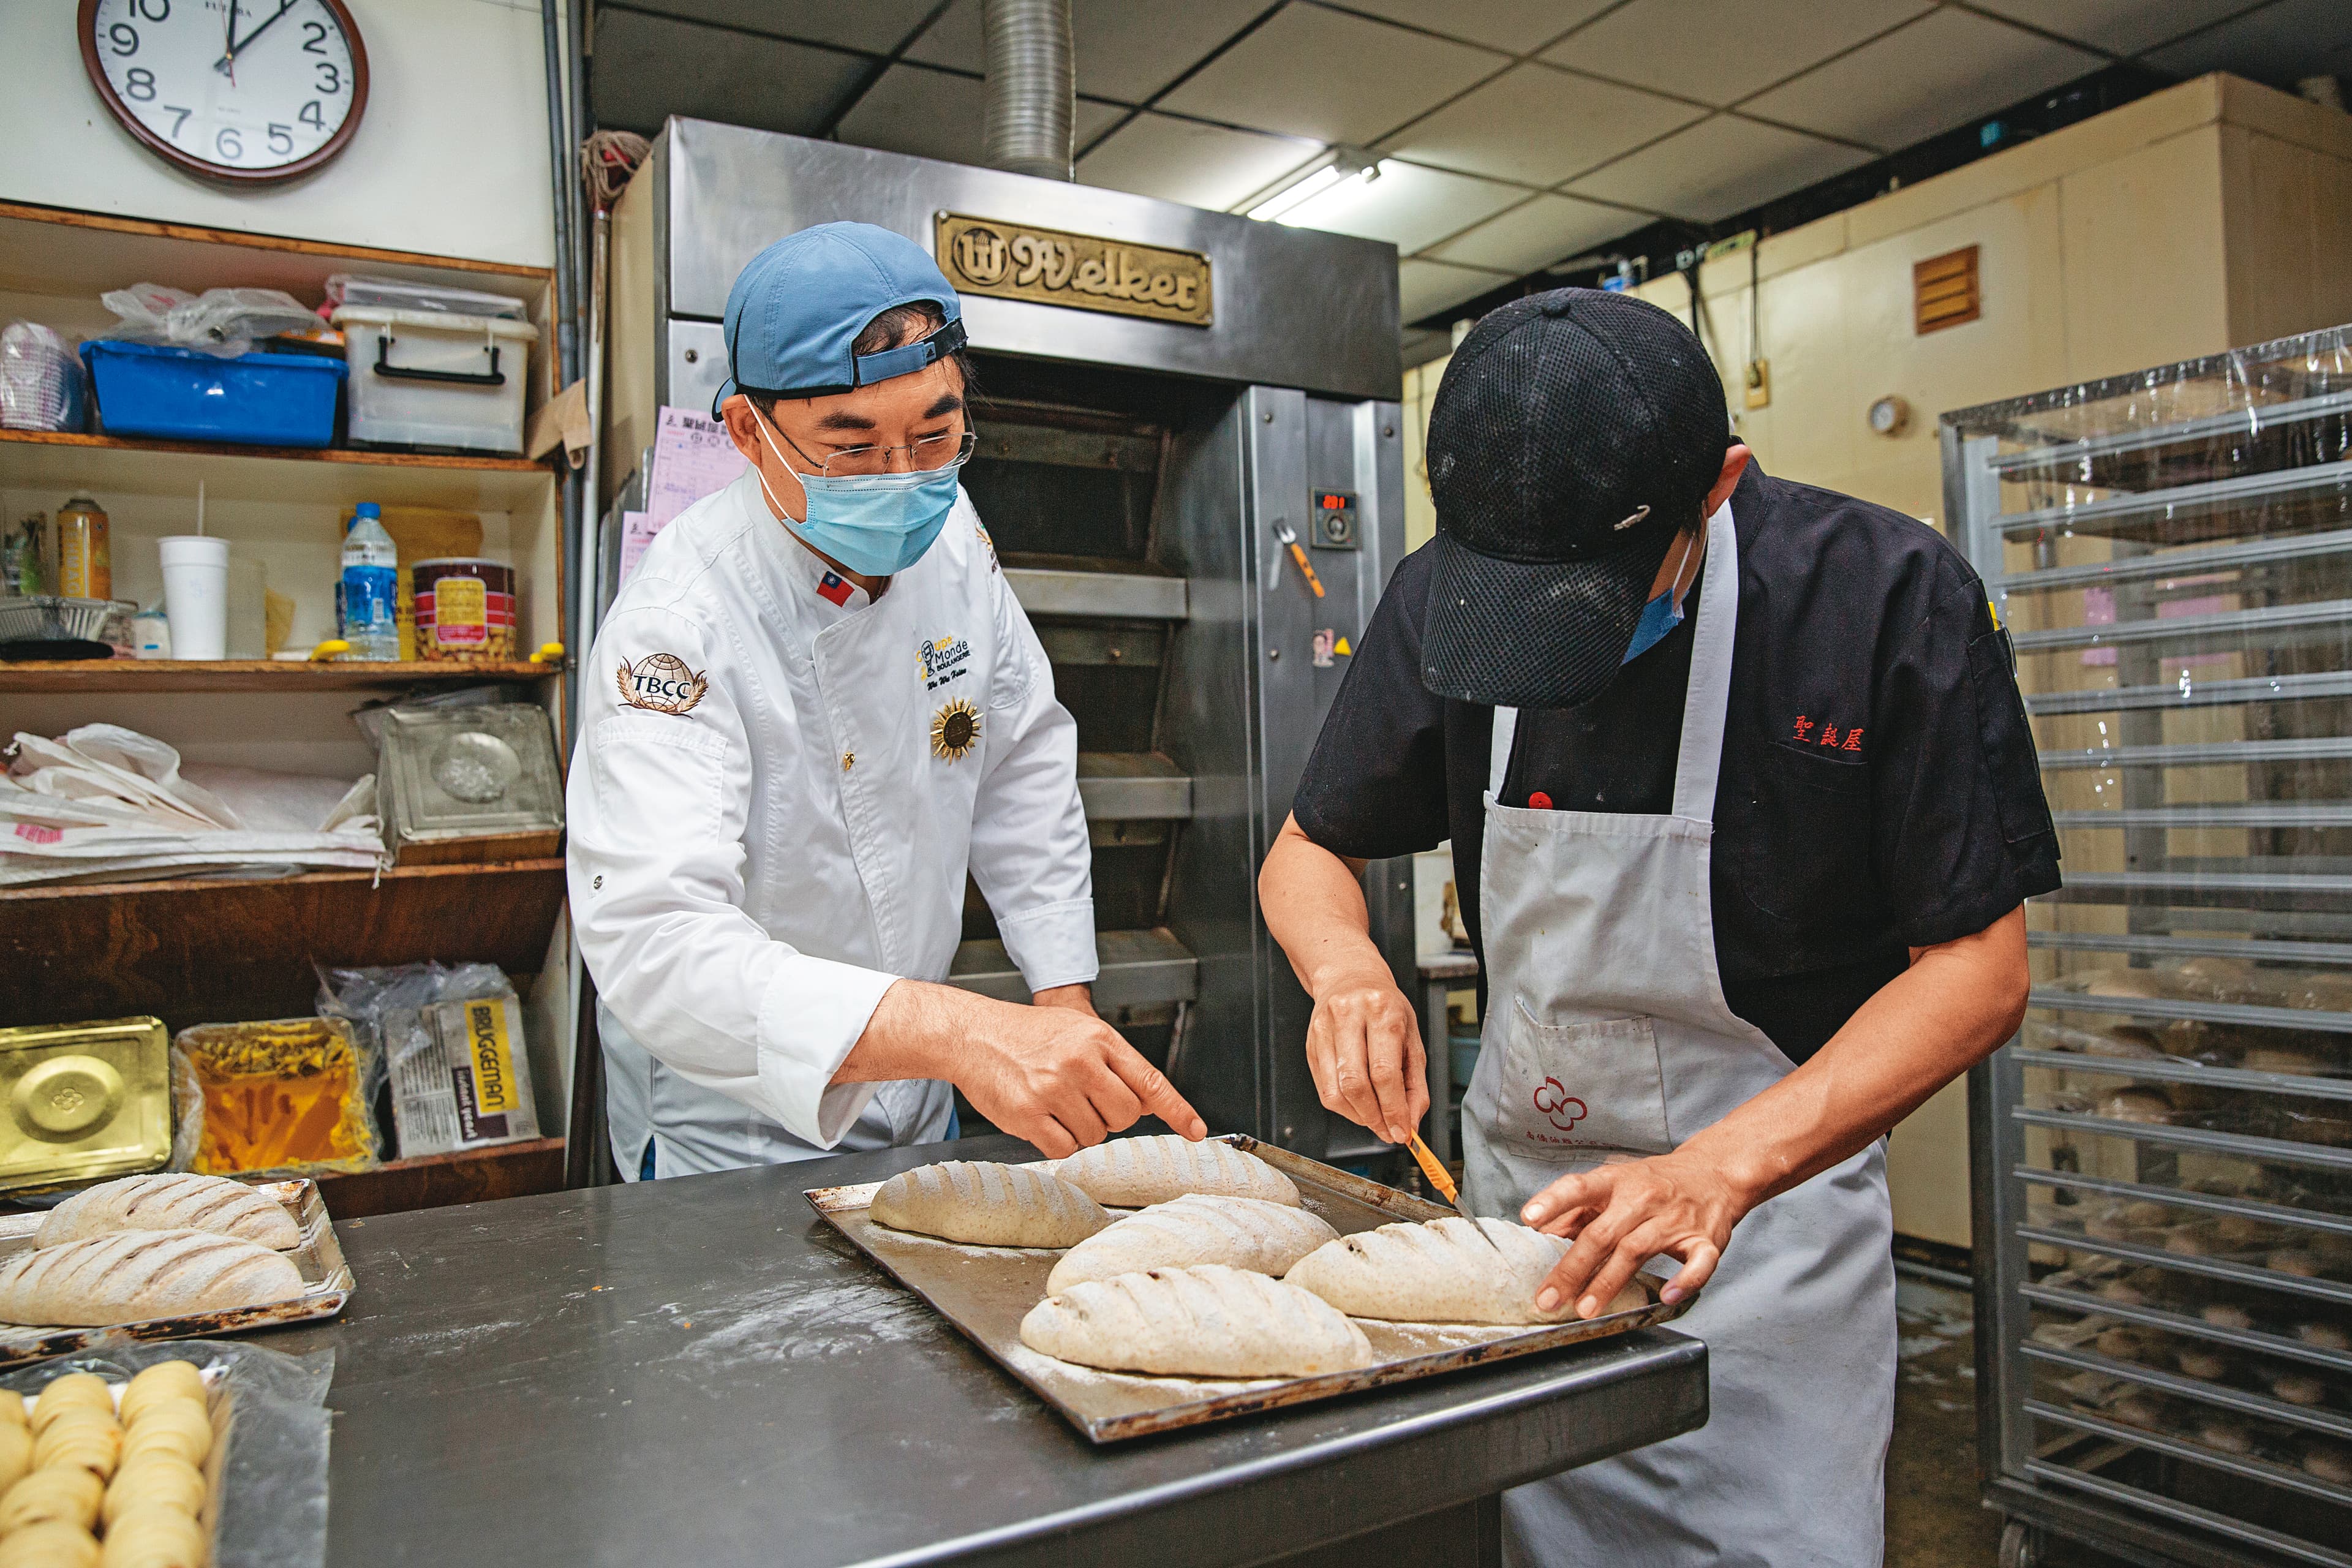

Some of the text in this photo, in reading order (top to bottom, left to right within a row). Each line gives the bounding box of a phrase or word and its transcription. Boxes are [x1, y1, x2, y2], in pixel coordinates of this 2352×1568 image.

[109, 23, 140, 57] 9
[302, 21, 327, 55] 2
[126, 67, 156, 101] 8
[315, 62, 340, 94] 3
[163, 105, 192, 139] 7
[298, 100, 325, 131] 4
[216, 127, 243, 159] 6
[267, 123, 294, 155] 5
[1011, 234, 1197, 311] Welker
[935, 640, 968, 663] Monde
[937, 649, 971, 672] BOULANGERIE
[633, 674, 691, 699] TBCC
[471, 1005, 505, 1108] BRUGGEMAN
[460, 1107, 478, 1139] yeast
